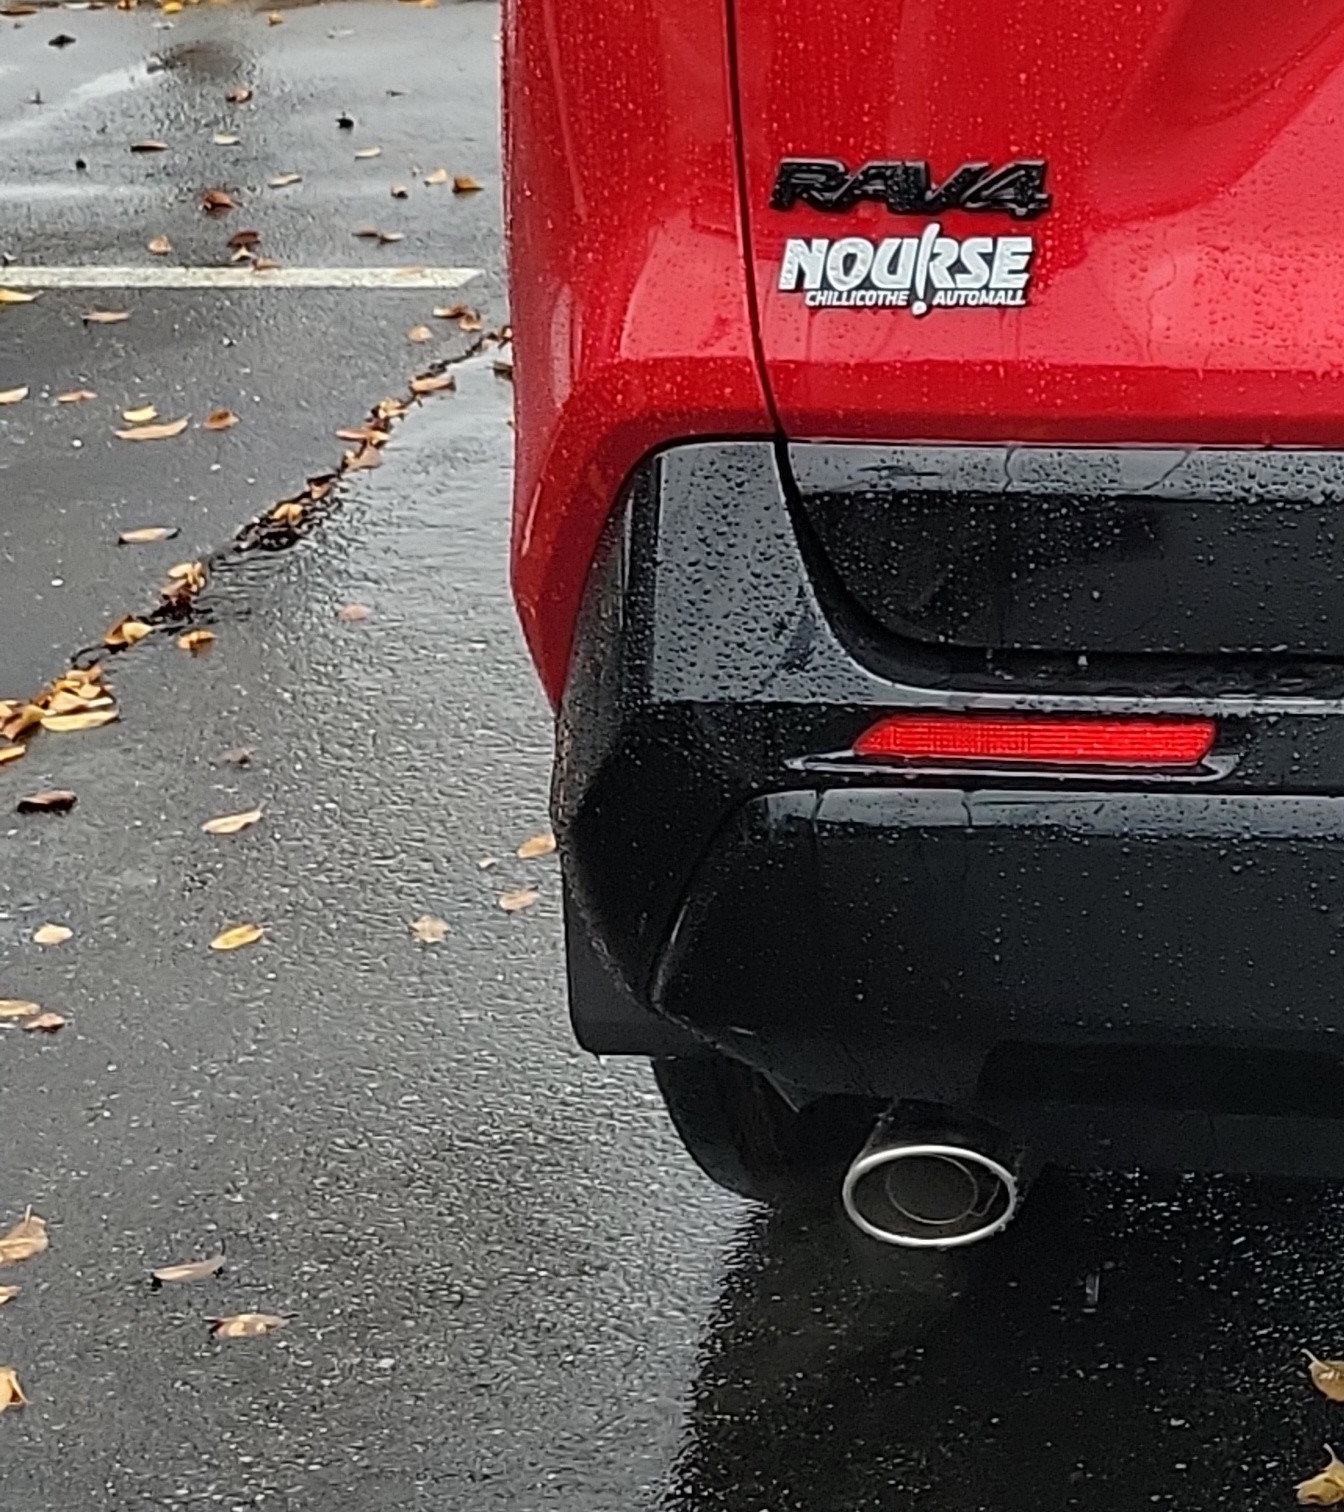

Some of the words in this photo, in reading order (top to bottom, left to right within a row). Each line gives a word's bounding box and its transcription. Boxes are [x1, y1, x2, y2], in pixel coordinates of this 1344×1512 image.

[771, 156, 1052, 217] RAV4
[779, 226, 1034, 300] NOURSE
[804, 289, 910, 307] CHILLICOTHE
[931, 289, 1027, 307] AUTOMALL
